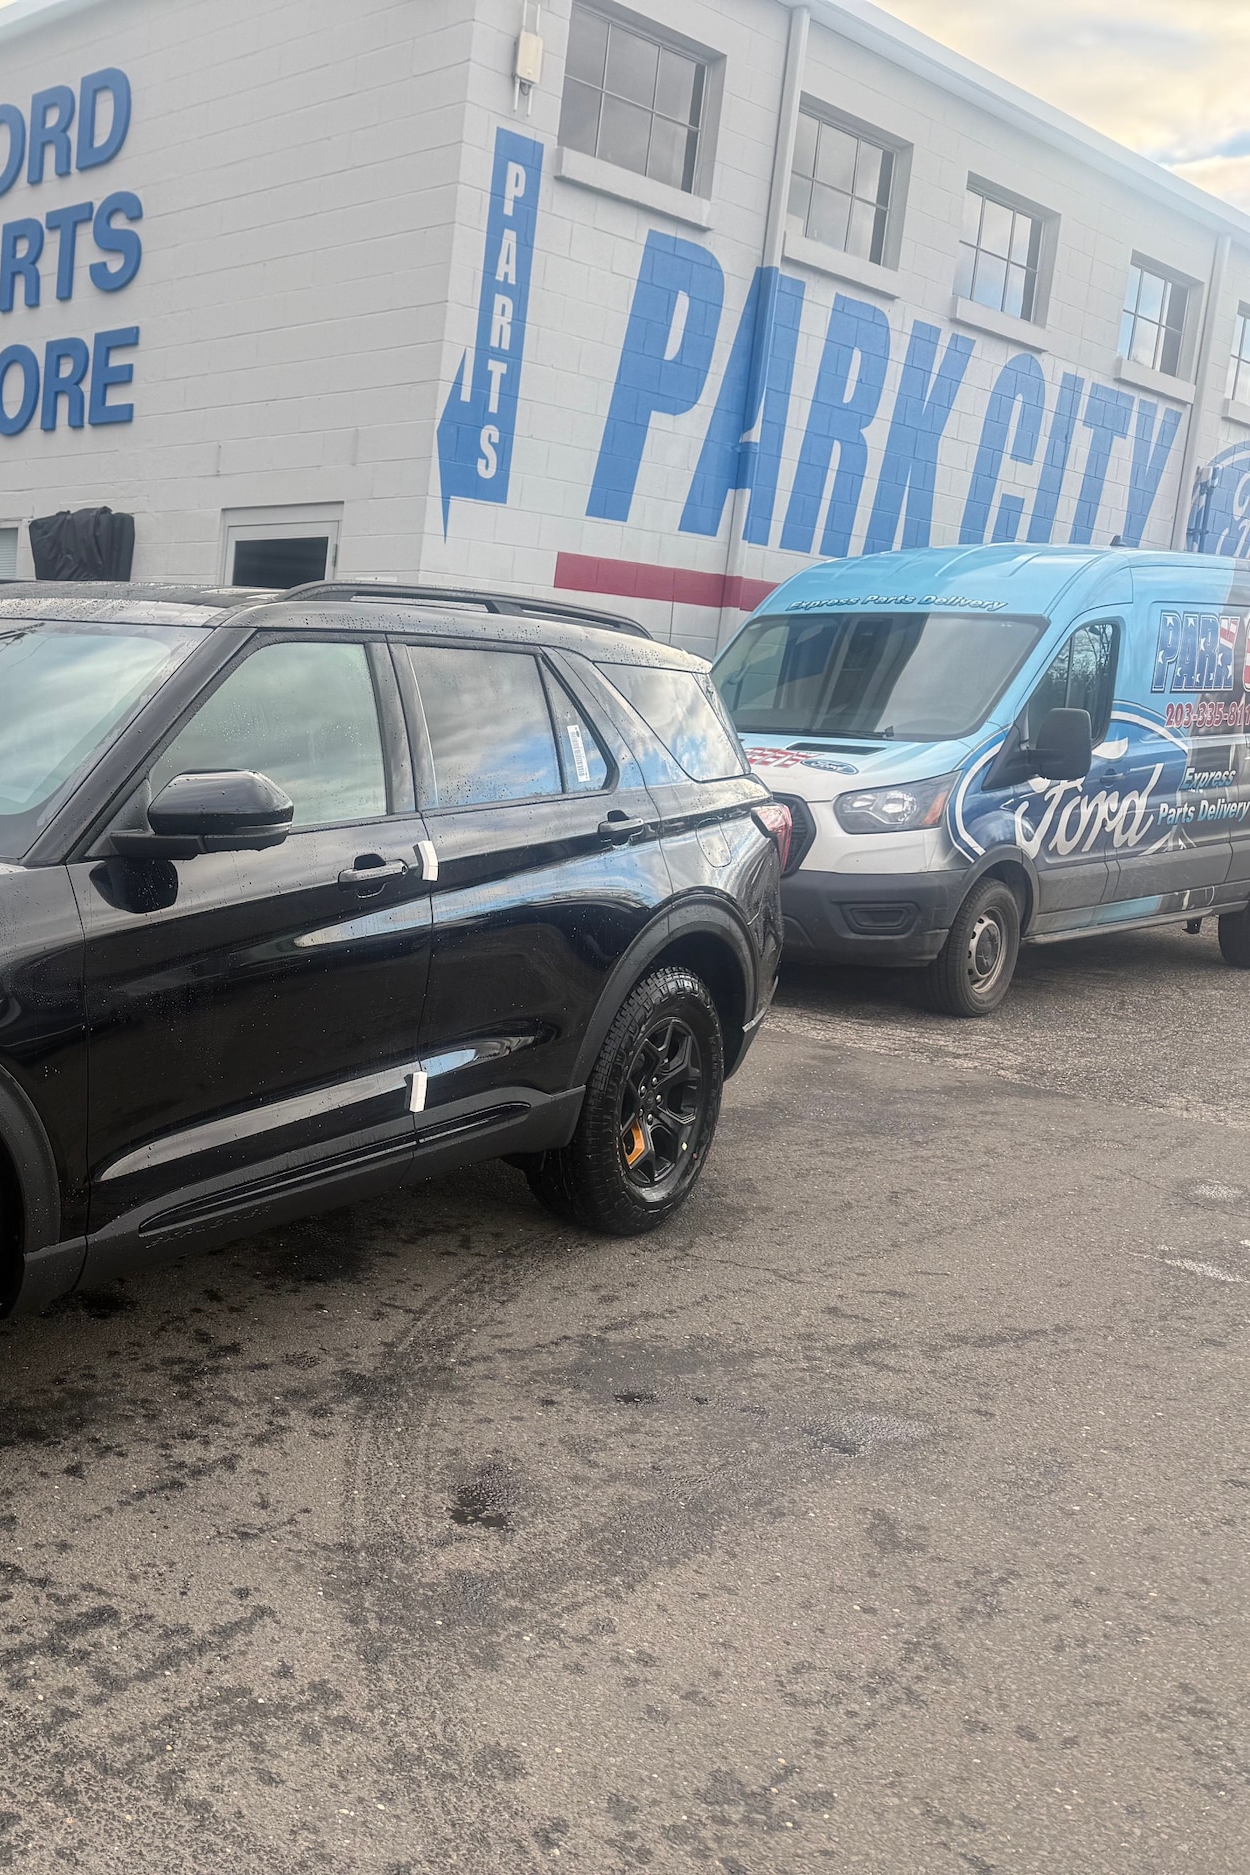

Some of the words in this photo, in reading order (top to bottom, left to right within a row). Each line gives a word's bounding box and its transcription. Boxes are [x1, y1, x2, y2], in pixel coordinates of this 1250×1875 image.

[477, 161, 526, 480] PARTS
[586, 228, 976, 557] PARK
[959, 352, 1182, 546] CITY
[785, 596, 861, 611] Express
[861, 594, 916, 605] Parts
[918, 594, 1009, 611] Delivery
[1150, 609, 1240, 693] PARK
[1006, 752, 1164, 860] Ford
[1156, 802, 1196, 825] Parts
[1197, 798, 1250, 822] Delivery
[1180, 767, 1237, 793] Express
